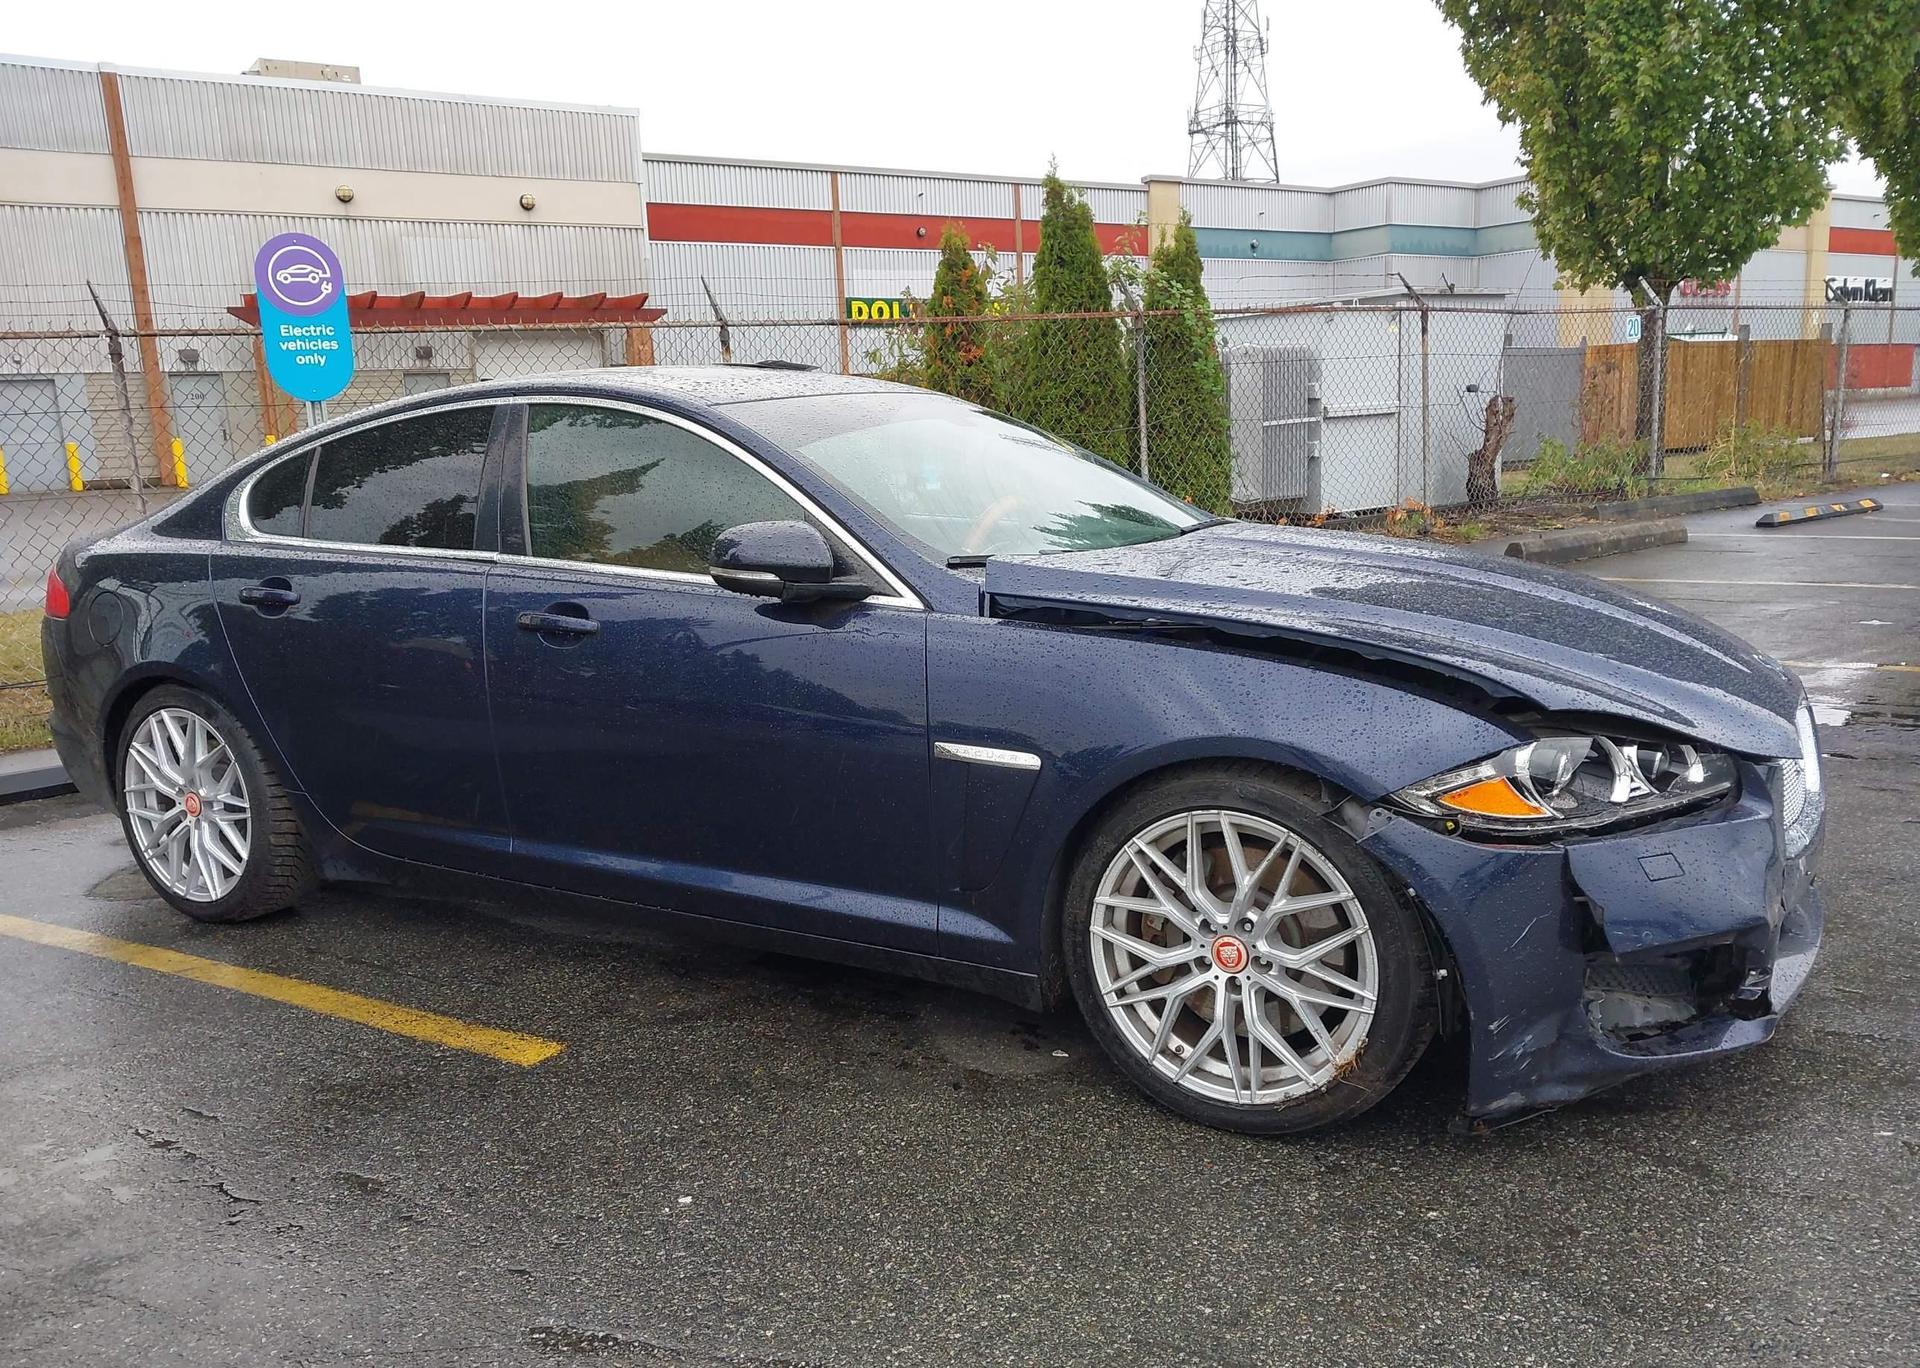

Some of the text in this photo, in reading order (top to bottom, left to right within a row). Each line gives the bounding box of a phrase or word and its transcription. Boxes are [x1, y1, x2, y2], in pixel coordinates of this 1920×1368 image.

[280, 324, 335, 336] Electric
[1628, 318, 1639, 337] 20
[279, 338, 339, 351] vehicles
[296, 353, 326, 366] only
